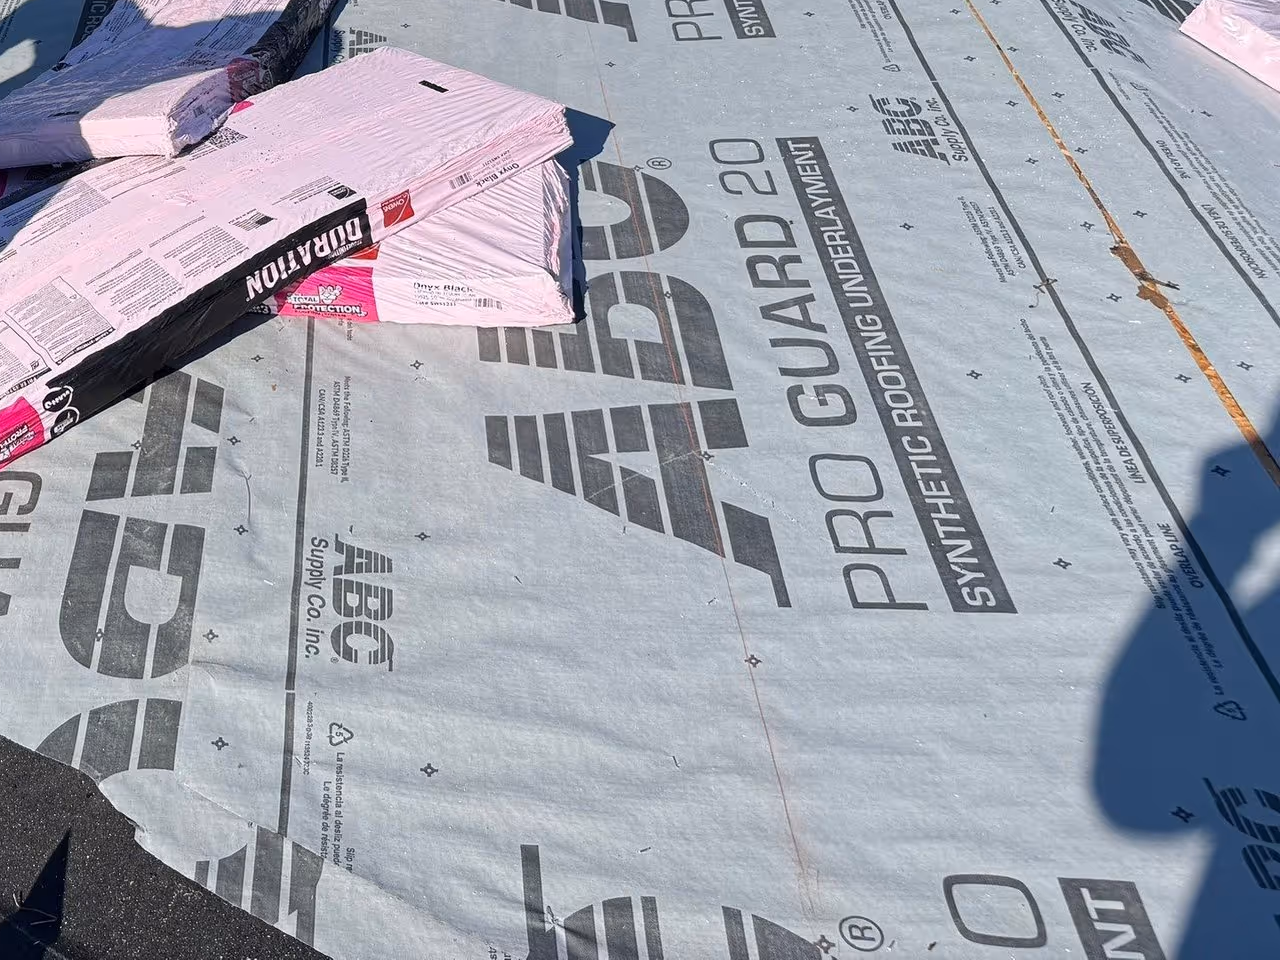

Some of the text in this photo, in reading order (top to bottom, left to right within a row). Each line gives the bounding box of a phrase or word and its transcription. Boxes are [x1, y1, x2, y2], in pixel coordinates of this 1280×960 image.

[869, 94, 951, 166] ABC
[934, 113, 951, 128] Co.
[940, 129, 969, 162] Supply
[474, 162, 521, 188] Onyx Black
[383, 198, 405, 213] OWENS
[789, 141, 869, 307] UNDERLAYMENT
[245, 216, 364, 301] DURATION
[293, 295, 318, 304] TOTAL
[293, 304, 363, 315] PROTECTION
[708, 138, 929, 611] PRO GUARD 20
[855, 314, 924, 428] ROOFING
[332, 381, 341, 397] ASTM
[330, 417, 340, 430] Type
[1081, 381, 1147, 485] LÍNEA DE SUPERPOSICIÓN
[316, 436, 325, 447] and
[330, 439, 340, 457] ASTM
[341, 428, 351, 446] ASTM
[339, 462, 350, 476] Type
[904, 436, 997, 608] SYNTHETIC
[304, 537, 329, 589] Supply
[1156, 521, 1202, 589] OVERLAP LINE
[307, 594, 326, 622] Co.
[331, 533, 396, 672] ABC
[335, 752, 345, 762] La
[334, 762, 344, 808] resistencia
[334, 809, 343, 817] al
[320, 821, 330, 832] de
[344, 847, 355, 861] Slip
